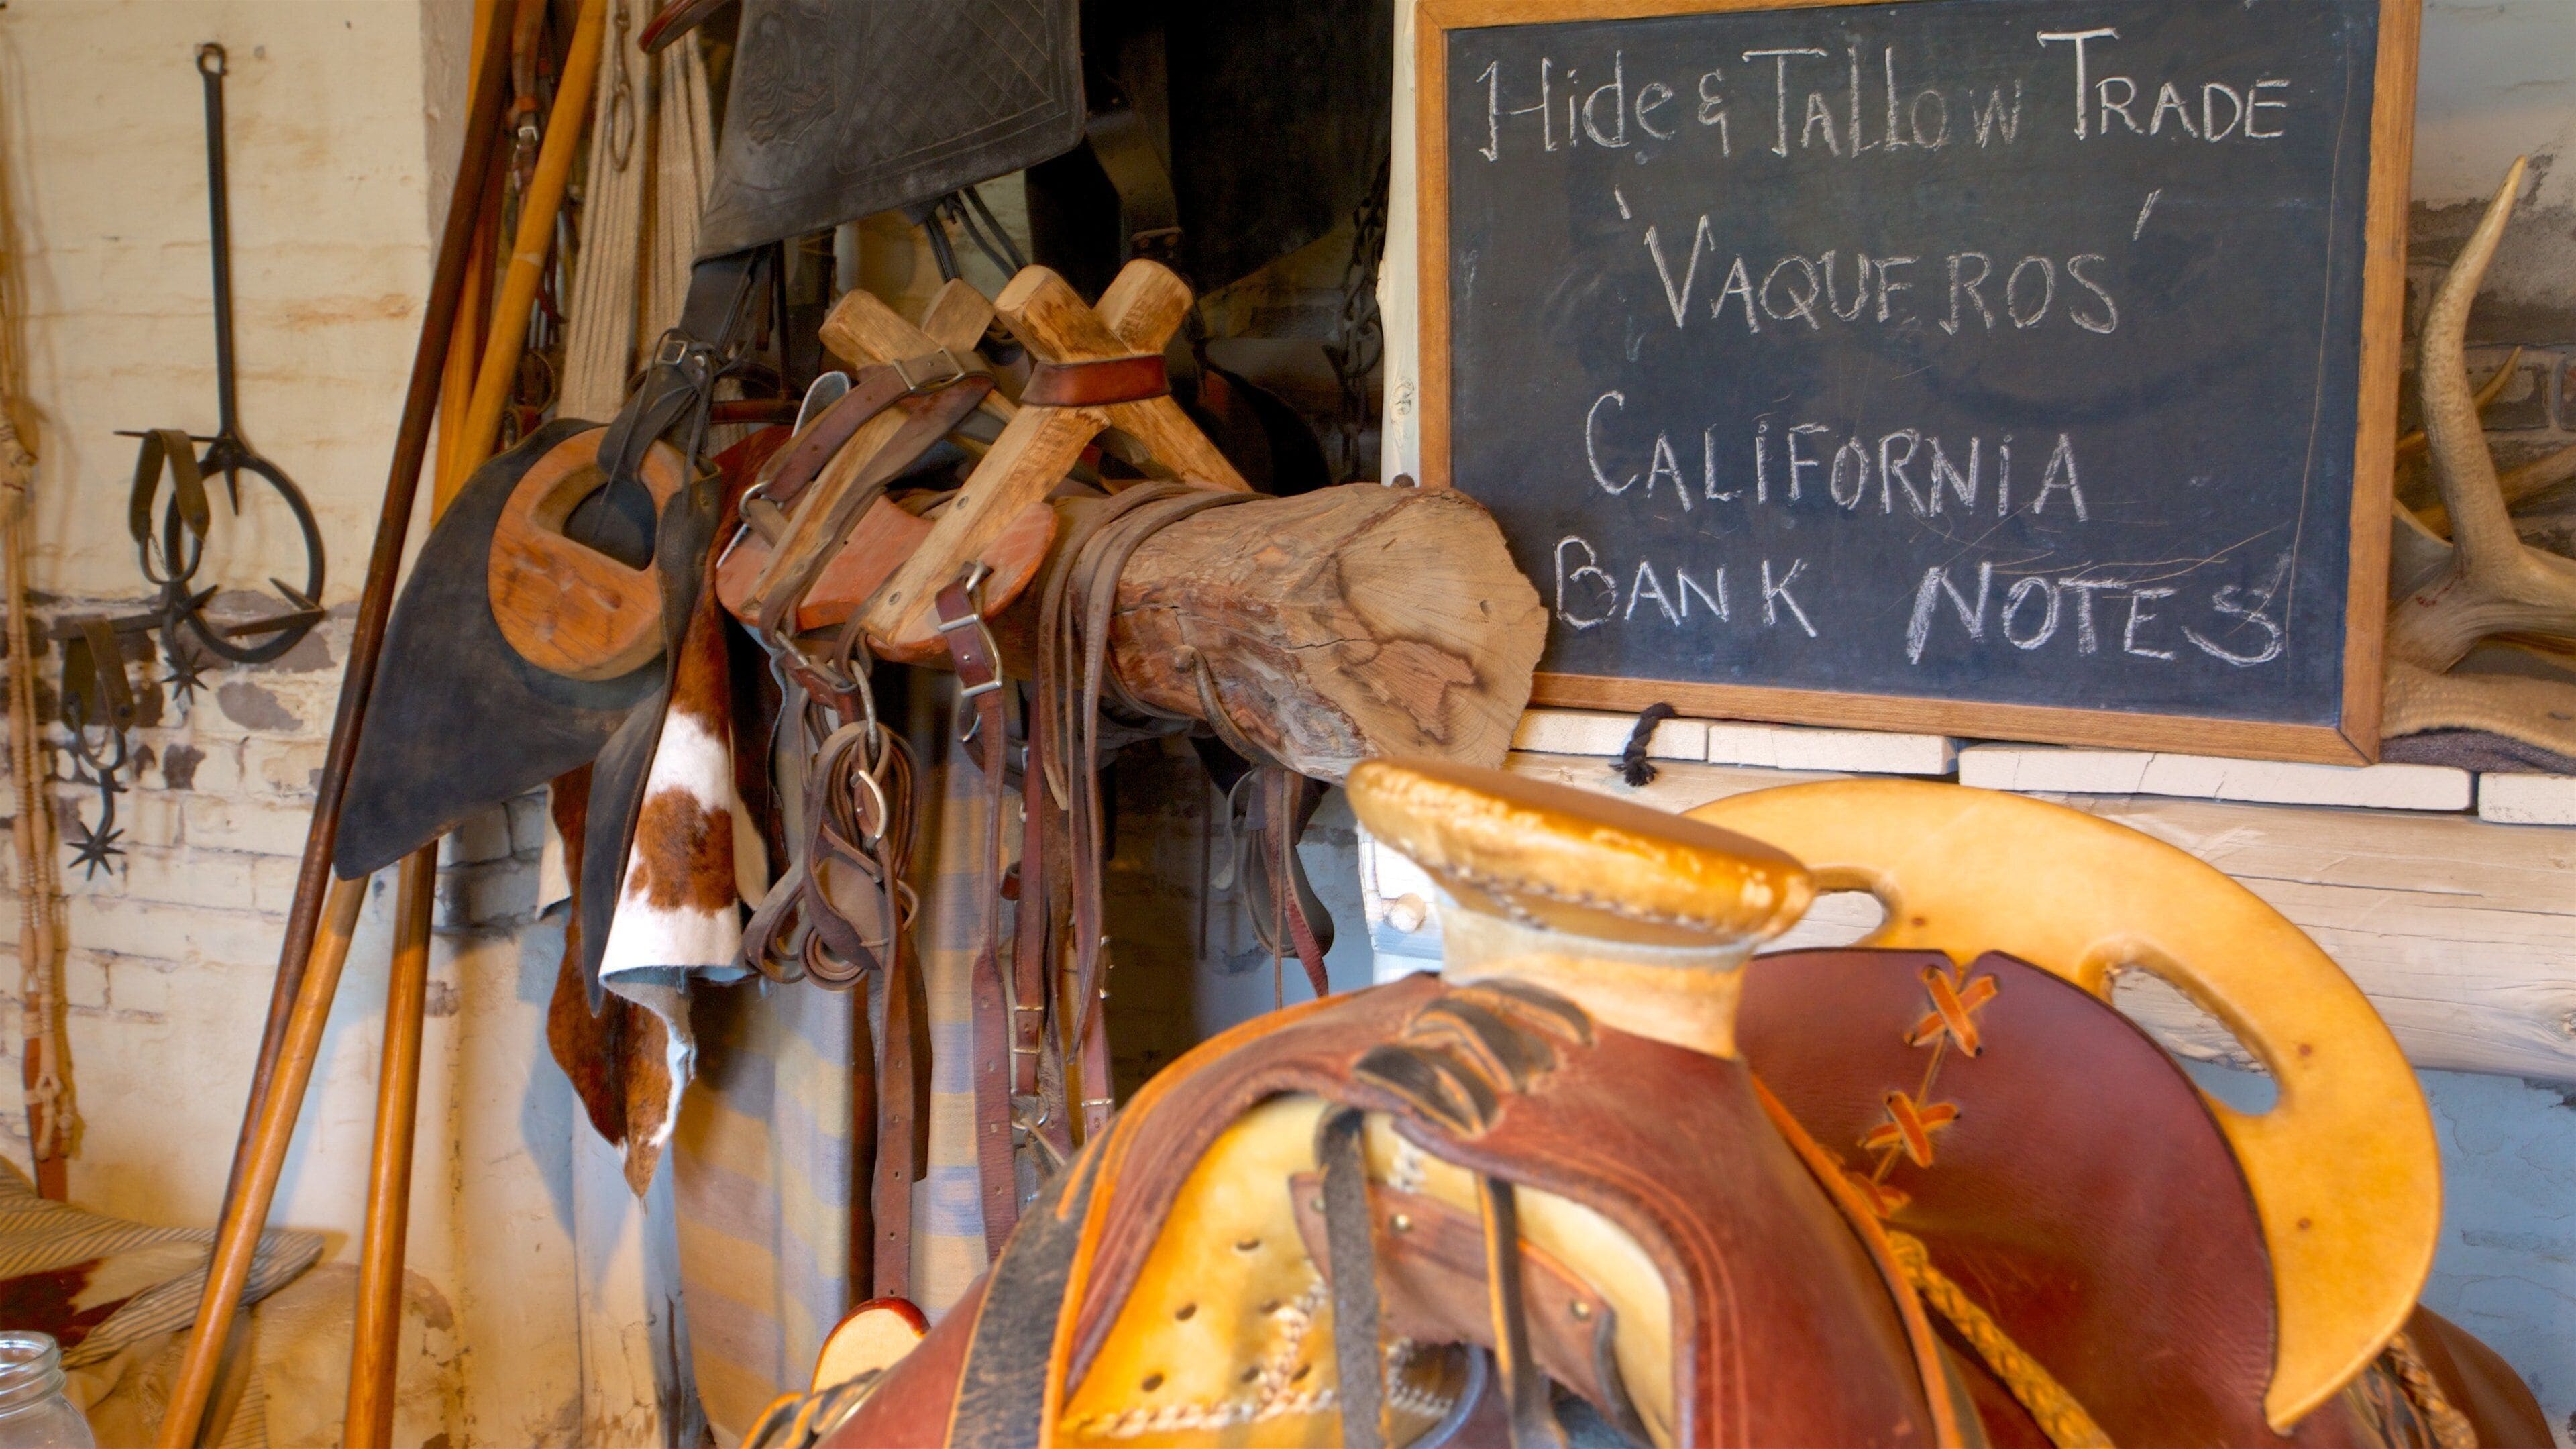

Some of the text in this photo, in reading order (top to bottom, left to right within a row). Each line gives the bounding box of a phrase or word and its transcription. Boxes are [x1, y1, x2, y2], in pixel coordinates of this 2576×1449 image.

[1476, 50, 1676, 162] Hide
[2036, 27, 2292, 143] TRADE
[1553, 535, 2285, 668] BANK NOTES
